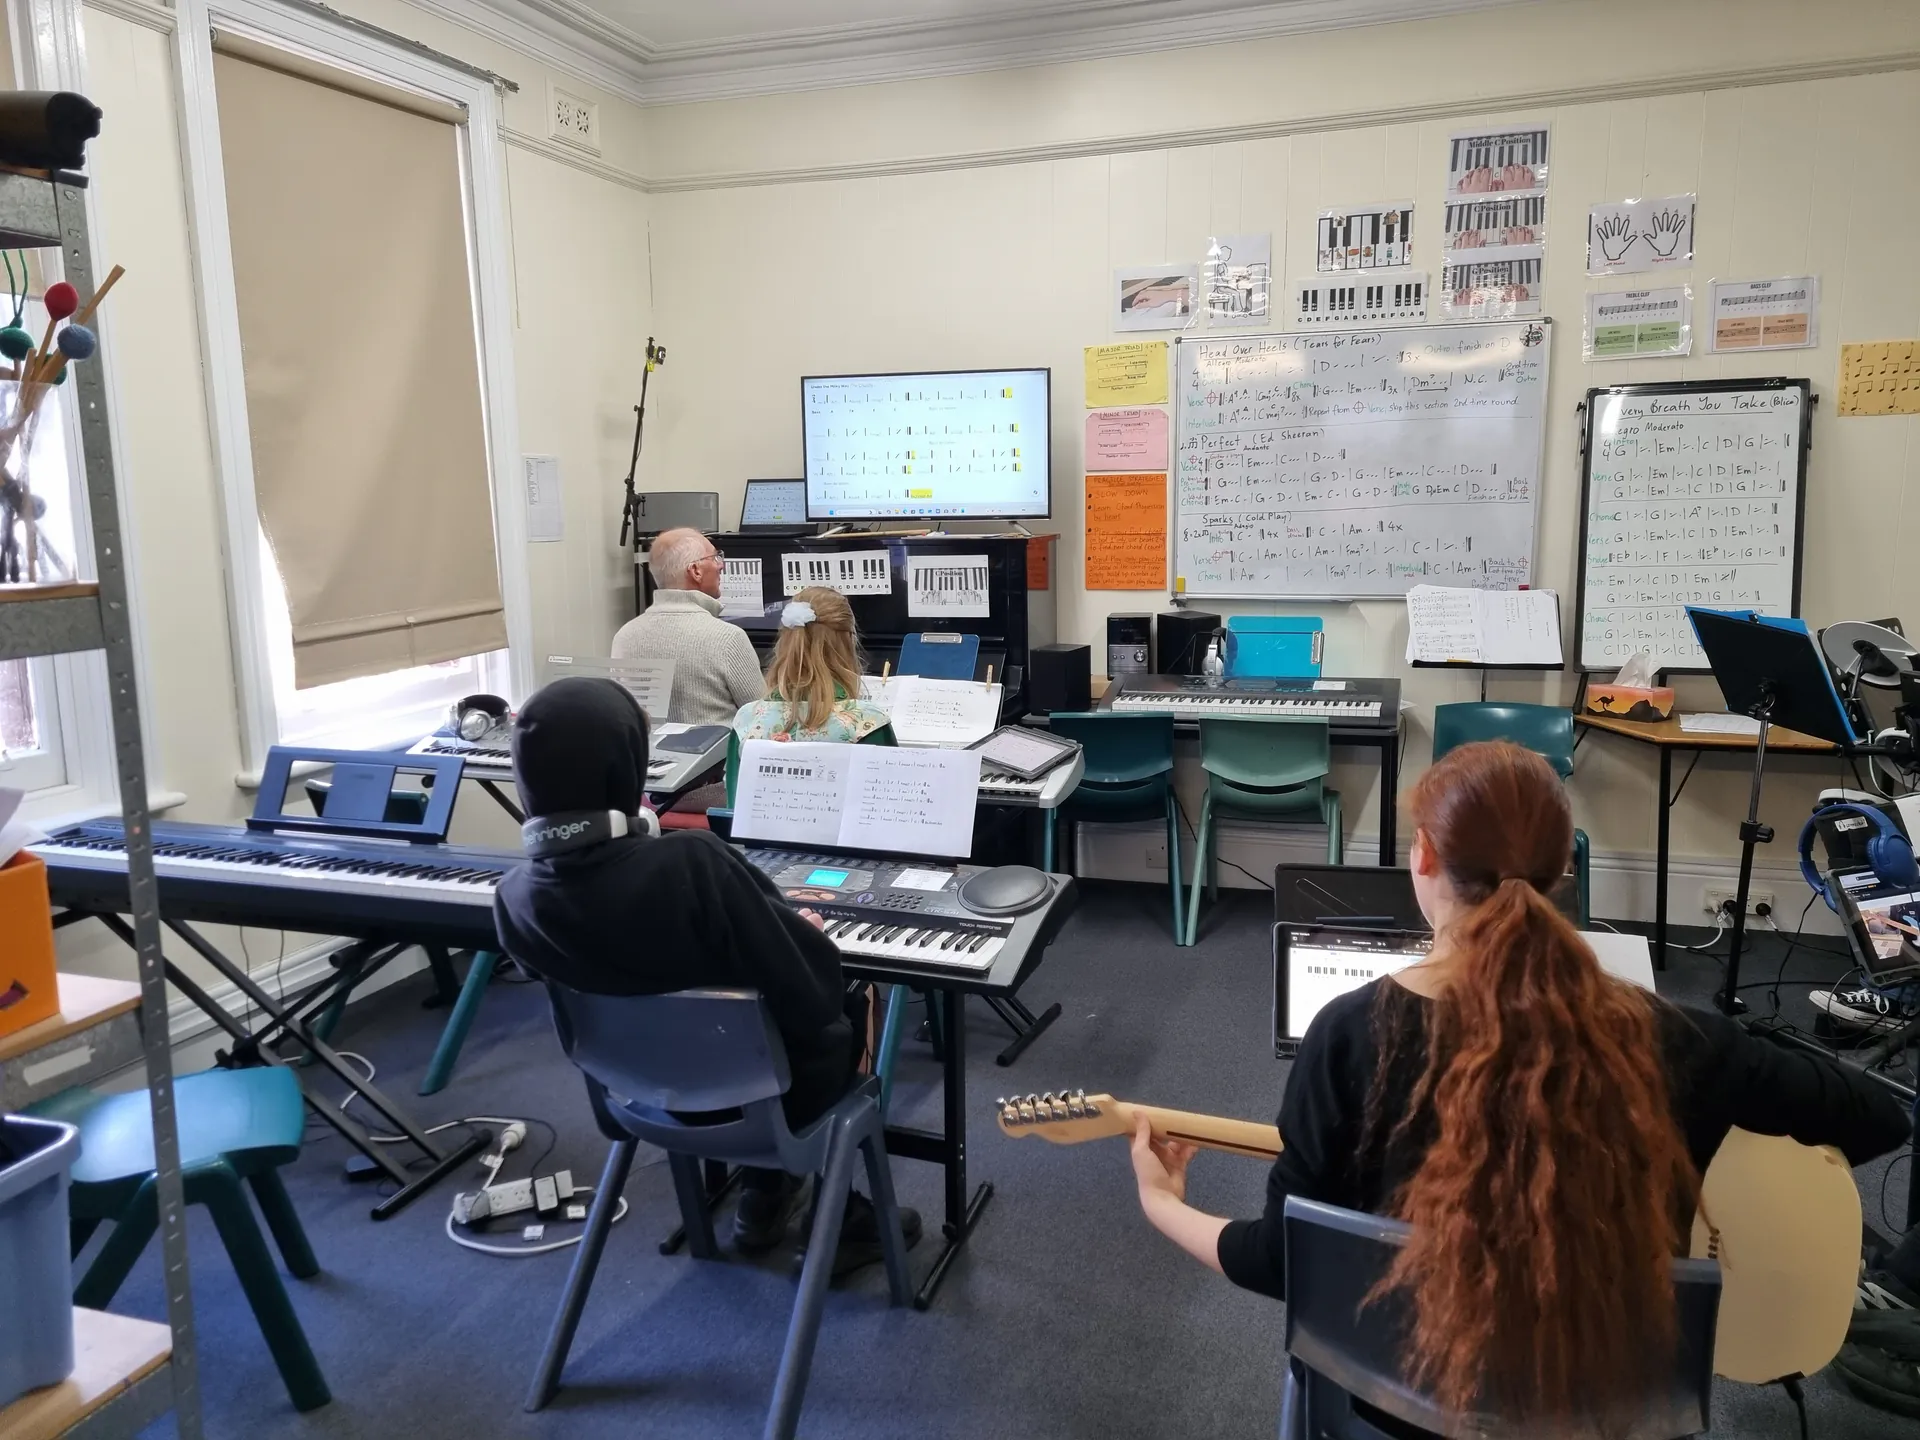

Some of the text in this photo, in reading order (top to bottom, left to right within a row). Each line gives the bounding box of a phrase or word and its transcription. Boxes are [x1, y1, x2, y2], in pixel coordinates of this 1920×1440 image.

[1501, 137, 1531, 145] Position
[1200, 345, 1228, 359] Head
[1233, 345, 1252, 355] Over
[1259, 342, 1287, 354] Heels
[1333, 336, 1346, 348] for
[1350, 334, 1381, 345] Fears)
[1308, 406, 1329, 417] Repeat
[1333, 406, 1350, 416] from
[1405, 400, 1420, 410] this
[1424, 402, 1448, 410] section
[1454, 398, 1468, 407] 2nd
[1471, 398, 1487, 406] time
[1650, 399, 1690, 413] Breath
[1699, 396, 1722, 410] You
[1732, 395, 1767, 408] Take
[1770, 395, 1799, 408] (Police)
[1645, 422, 1684, 432] Moderato
[1201, 435, 1242, 449] Perfect
[1281, 428, 1325, 439] Sheeran)
[1615, 437, 1754, 457] G Em C D G
[1614, 471, 1625, 483] G
[1653, 467, 1668, 479] Em
[1696, 467, 1703, 477] C
[1717, 465, 1726, 475] D
[1737, 464, 1751, 474] Em
[1614, 480, 1746, 498] G Em C D G
[1202, 514, 1233, 525] Sparks
[1650, 510, 1660, 520] G
[1731, 505, 1741, 516] D
[1614, 532, 1624, 543] G
[1650, 530, 1665, 541] Em
[1688, 529, 1695, 538] C
[1710, 526, 1718, 538] D
[1731, 525, 1747, 536] Em
[1663, 552, 1668, 561] F
[1745, 545, 1753, 557] G
[1609, 575, 1625, 586] Em
[1652, 575, 1659, 585] C
[1671, 573, 1679, 584] D
[1694, 574, 1709, 584] Em
